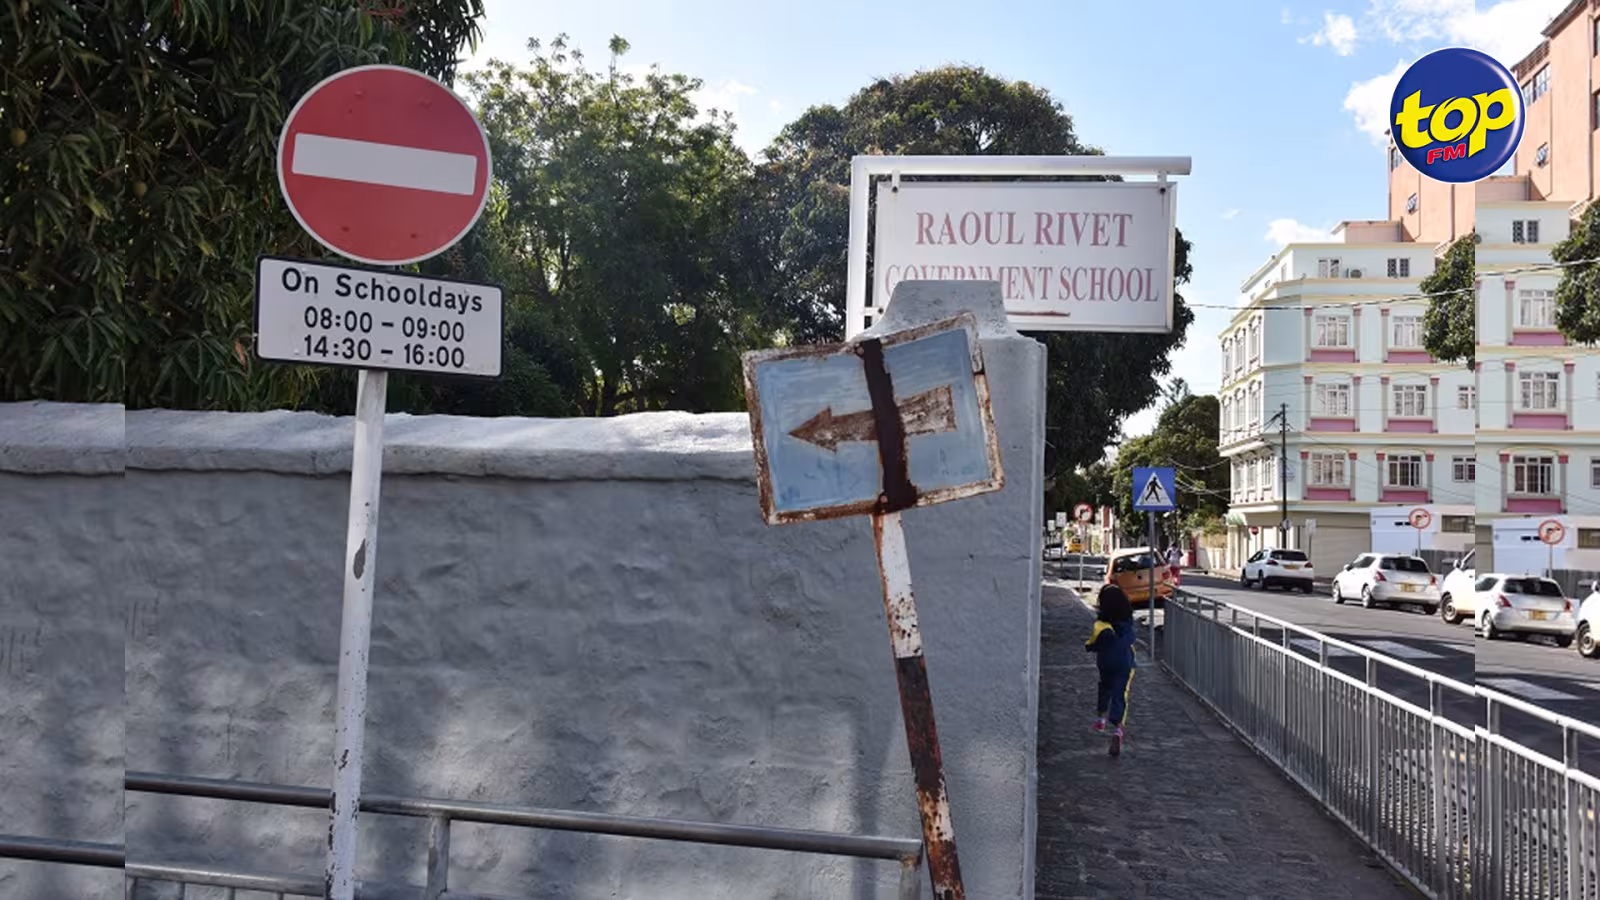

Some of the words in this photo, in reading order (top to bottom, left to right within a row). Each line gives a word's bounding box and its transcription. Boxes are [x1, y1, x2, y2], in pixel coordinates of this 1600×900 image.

[915, 211, 1025, 245] RAOUL
[1033, 212, 1133, 247] RIVET
[282, 267, 318, 294] On
[335, 274, 483, 315] Schooldays
[1059, 266, 1159, 302] SCHOOL
[304, 306, 373, 333] 08:00
[402, 316, 465, 342] 09:00
[304, 334, 372, 360] 14:30
[404, 344, 465, 368] 16:00
